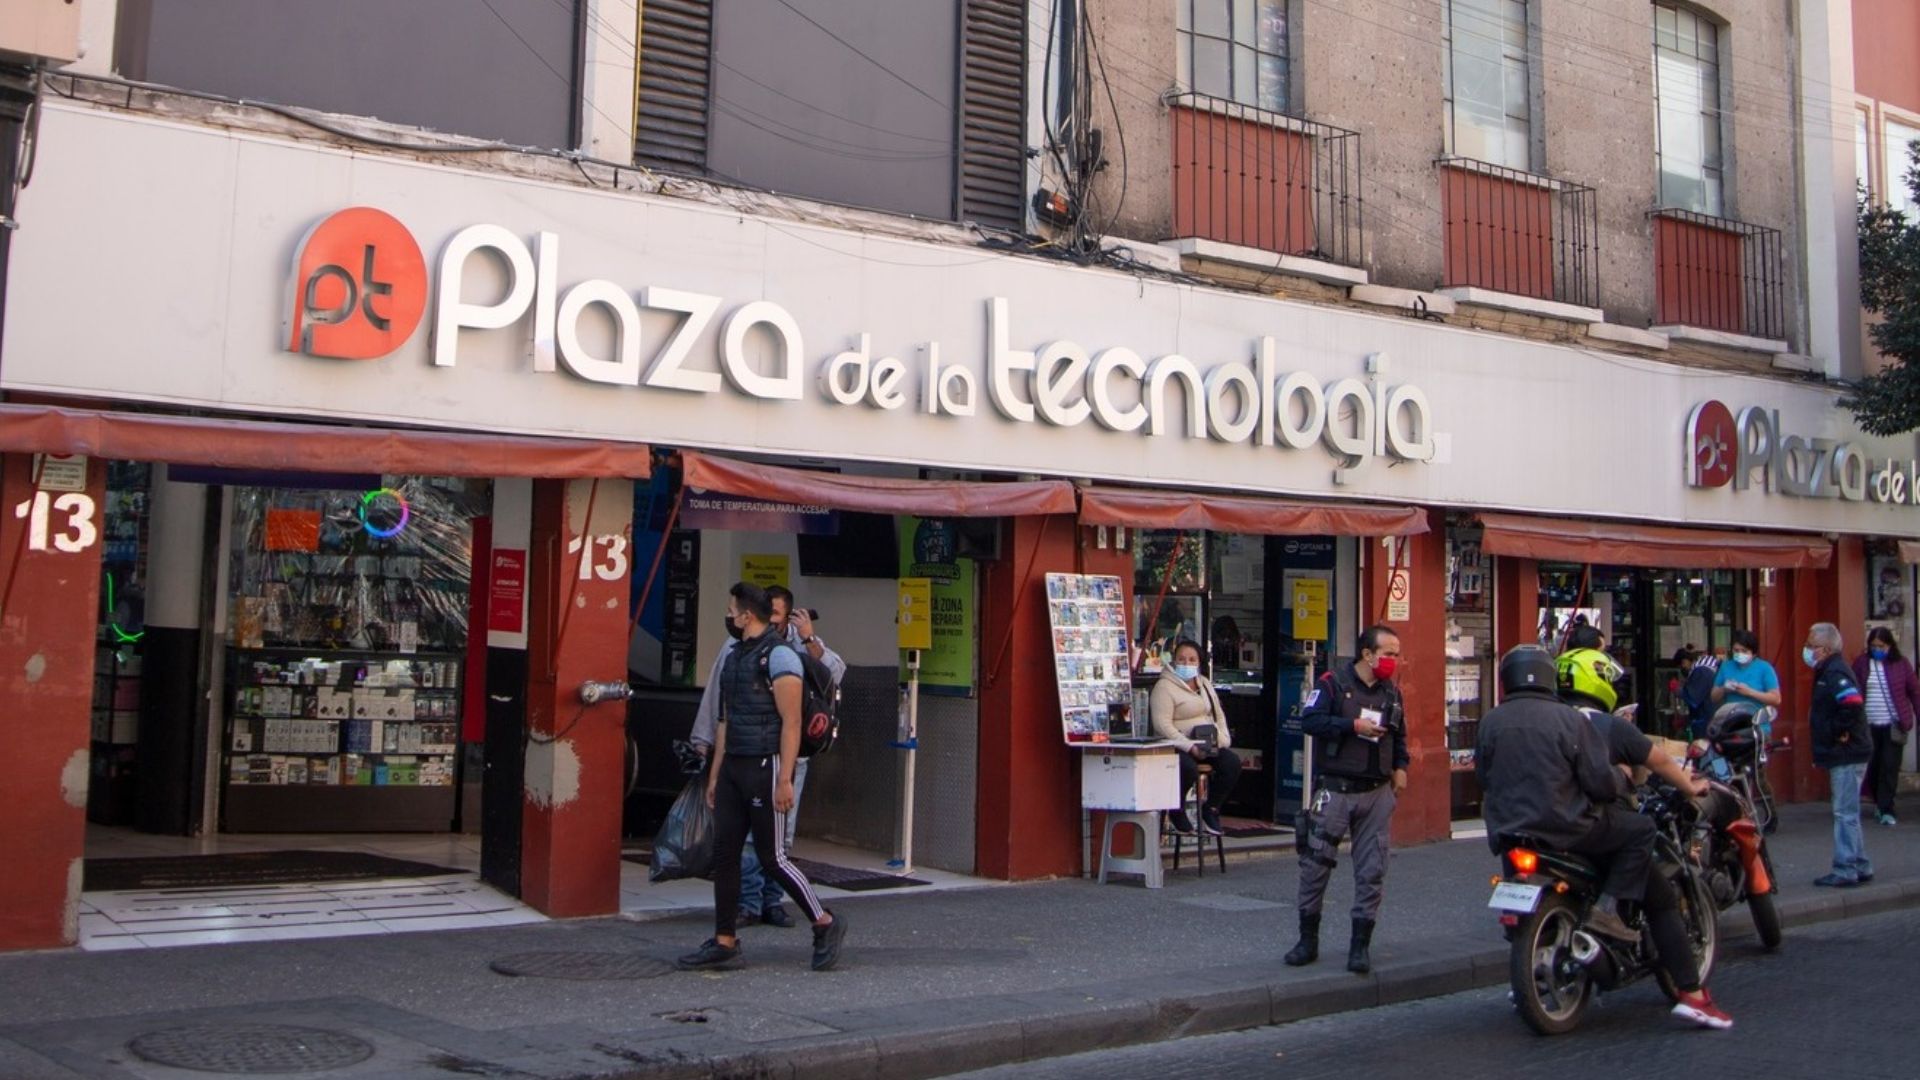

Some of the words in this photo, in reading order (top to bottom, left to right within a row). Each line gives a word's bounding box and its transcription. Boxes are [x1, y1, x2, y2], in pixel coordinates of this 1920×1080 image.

[433, 223, 804, 400] Plaza
[826, 333, 906, 410] de
[926, 341, 976, 417] la
[1736, 405, 1866, 501] Plaza
[1877, 457, 1905, 504] de
[15, 491, 97, 553] 13
[689, 499, 710, 509] TOMA
[711, 501, 722, 510] DE
[723, 501, 776, 513] TEMPERATURA
[776, 503, 796, 514] PARA
[568, 534, 628, 581] 13
[941, 597, 963, 612] ZONA
